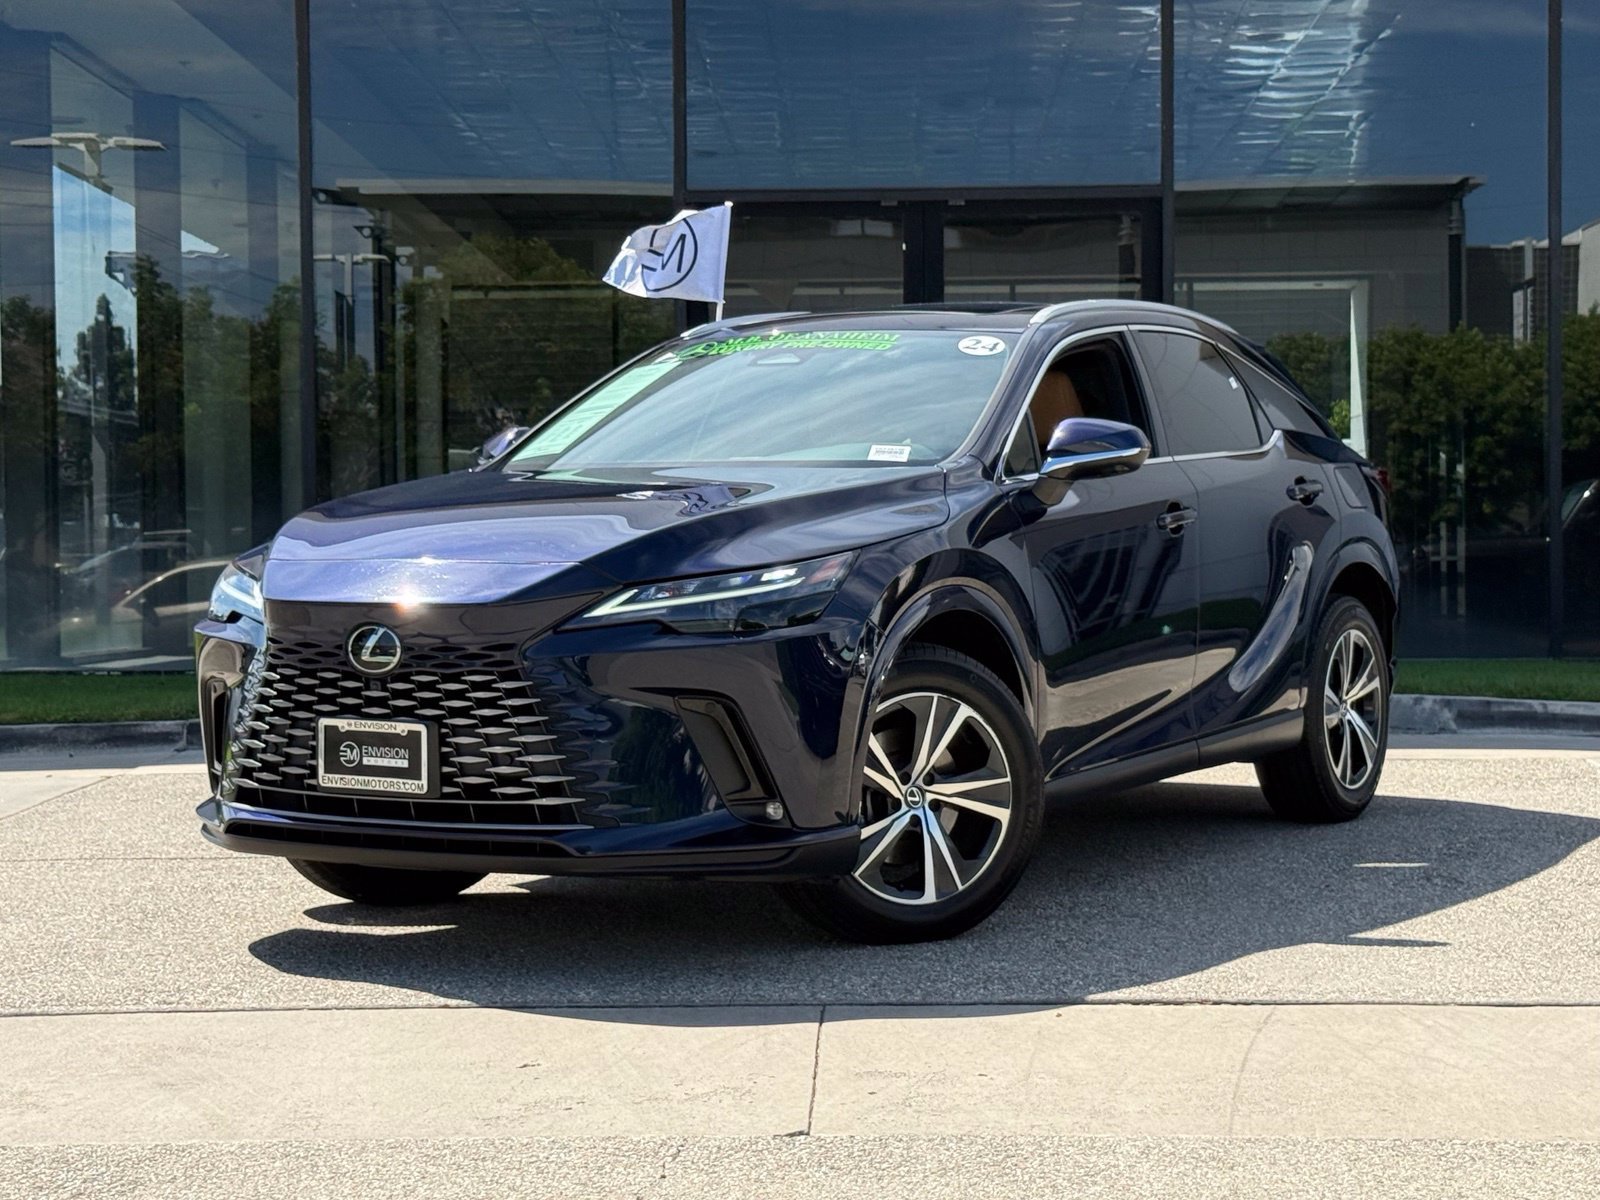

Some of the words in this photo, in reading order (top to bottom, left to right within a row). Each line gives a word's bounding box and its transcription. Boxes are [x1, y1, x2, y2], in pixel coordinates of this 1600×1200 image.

[782, 341, 892, 351] PRE-OWNED
[962, 338, 1000, 352] 24
[354, 721, 397, 730] ENVISION
[362, 745, 408, 759] ENVISION
[321, 775, 424, 792] ENVISIONMOTORS.COM
